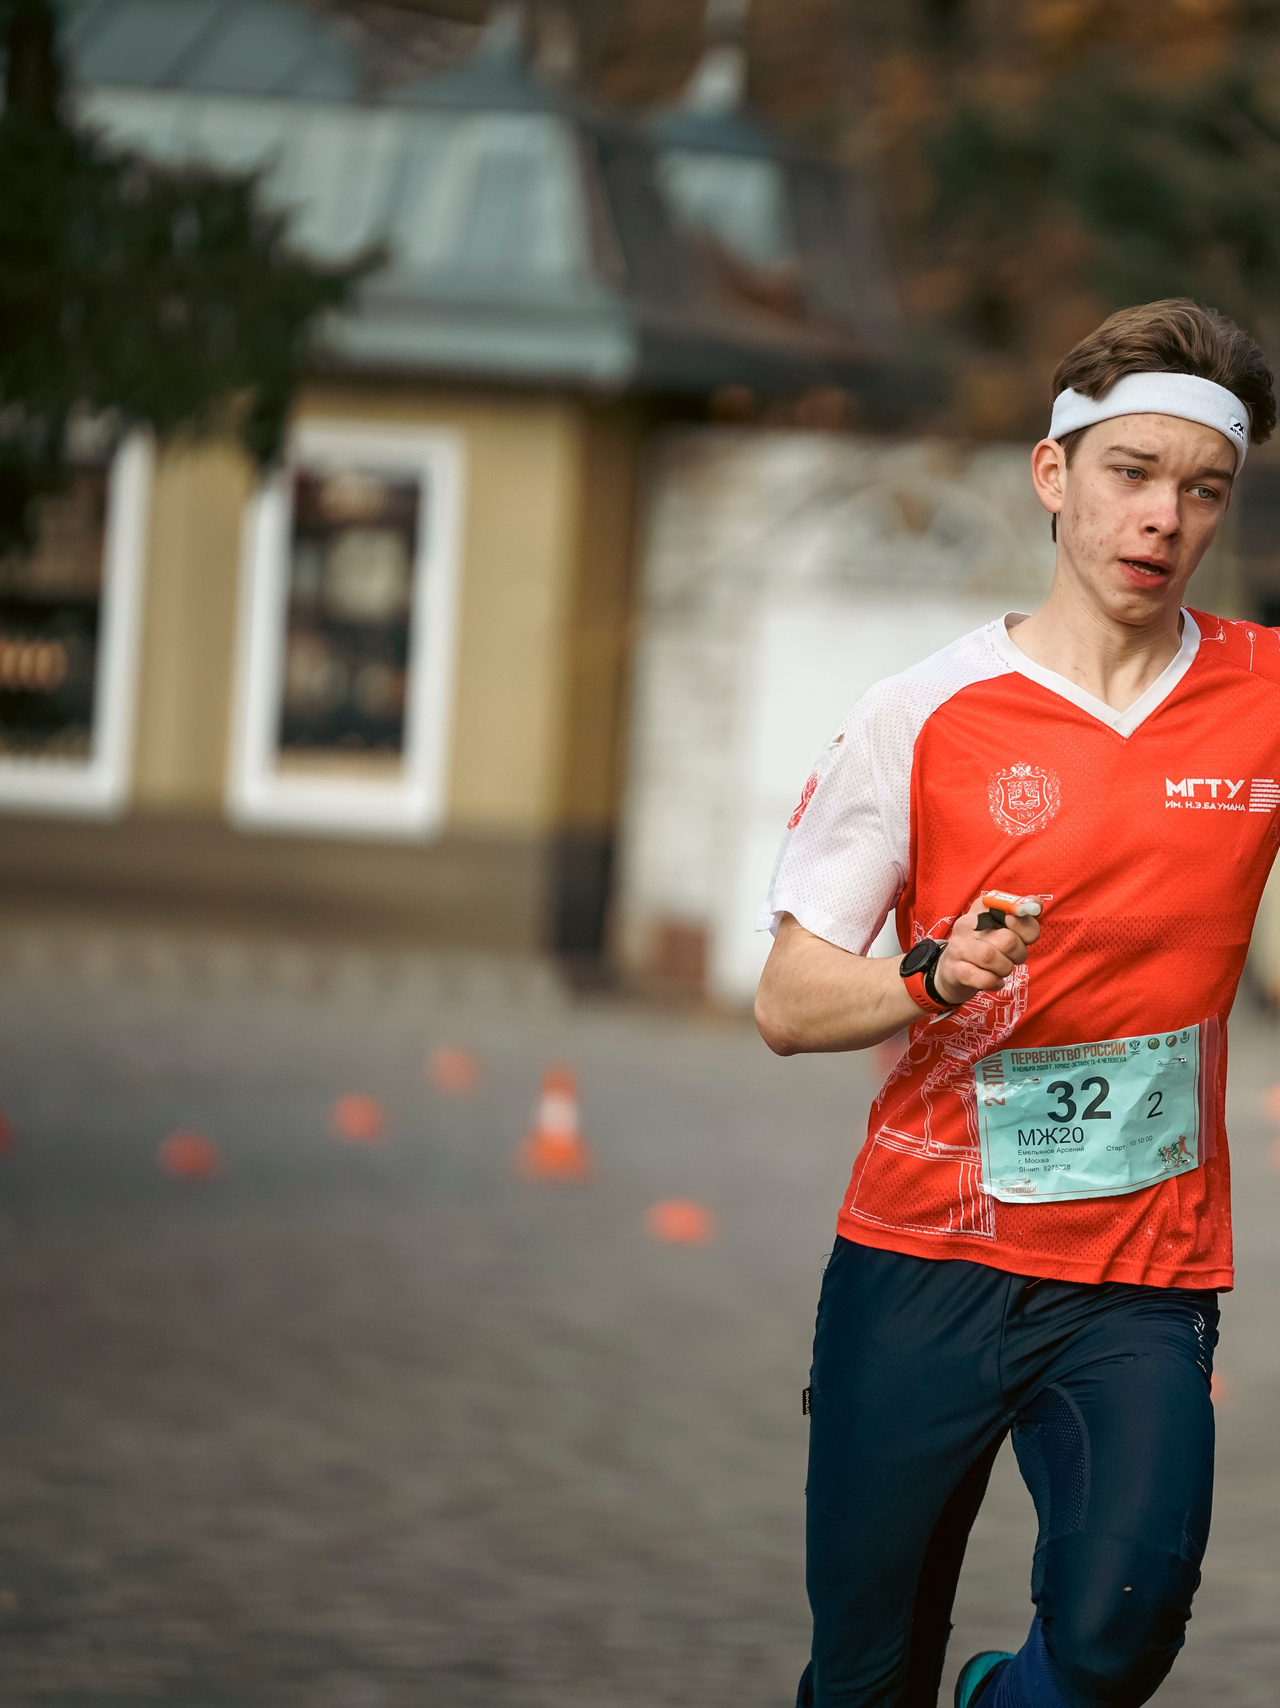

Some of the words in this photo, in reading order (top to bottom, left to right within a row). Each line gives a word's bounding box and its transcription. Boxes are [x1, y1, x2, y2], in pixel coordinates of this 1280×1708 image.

[1165, 777, 1246, 799] МГТУ
[1165, 800, 1184, 809] ИМ.
[1011, 1047, 1081, 1065] ПЕРВЕНСТВО
[1083, 1042, 1126, 1058] РОССИИ
[1016, 1064, 1036, 1072] НОЯБРЯ
[984, 1096, 1006, 1106] 2
[1046, 1076, 1111, 1123] 32
[1147, 1091, 1163, 1119] 2
[1018, 1127, 1084, 1146] МЖ20
[1056, 1146, 1085, 1154] Арсений
